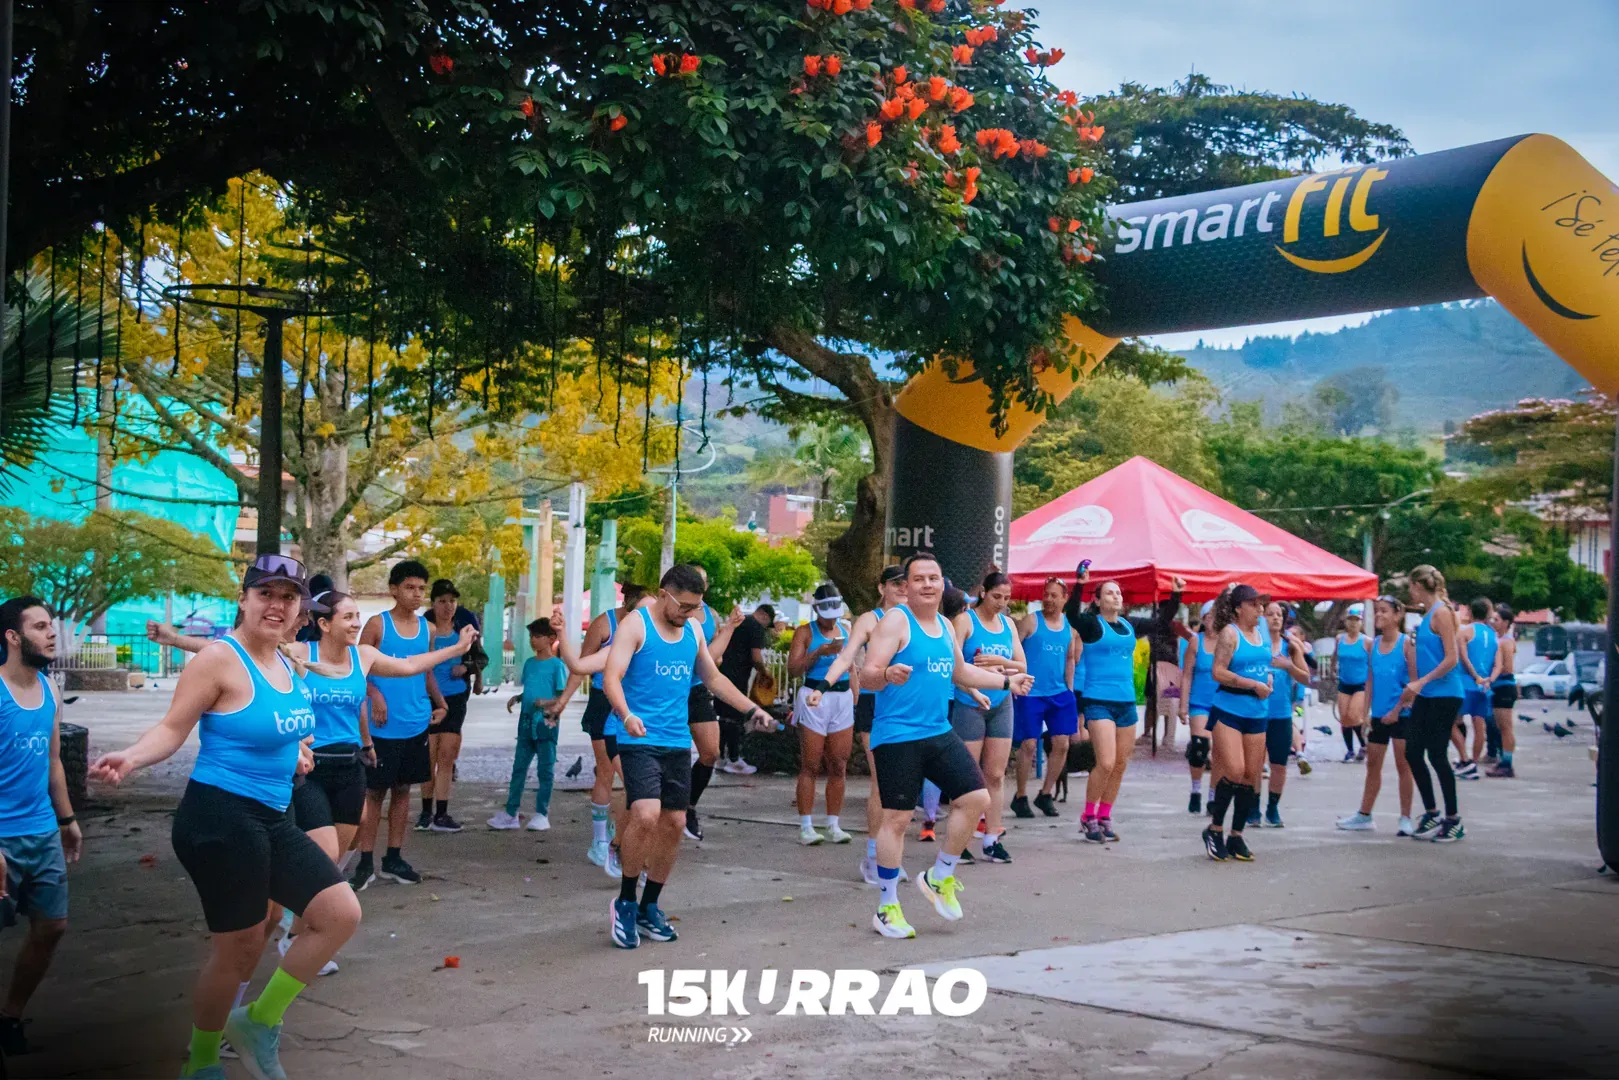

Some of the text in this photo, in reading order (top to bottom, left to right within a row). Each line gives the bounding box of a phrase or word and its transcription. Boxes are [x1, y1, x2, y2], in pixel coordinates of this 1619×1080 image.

[1115, 166, 1389, 254] smart fit
[655, 660, 692, 680] tonny
